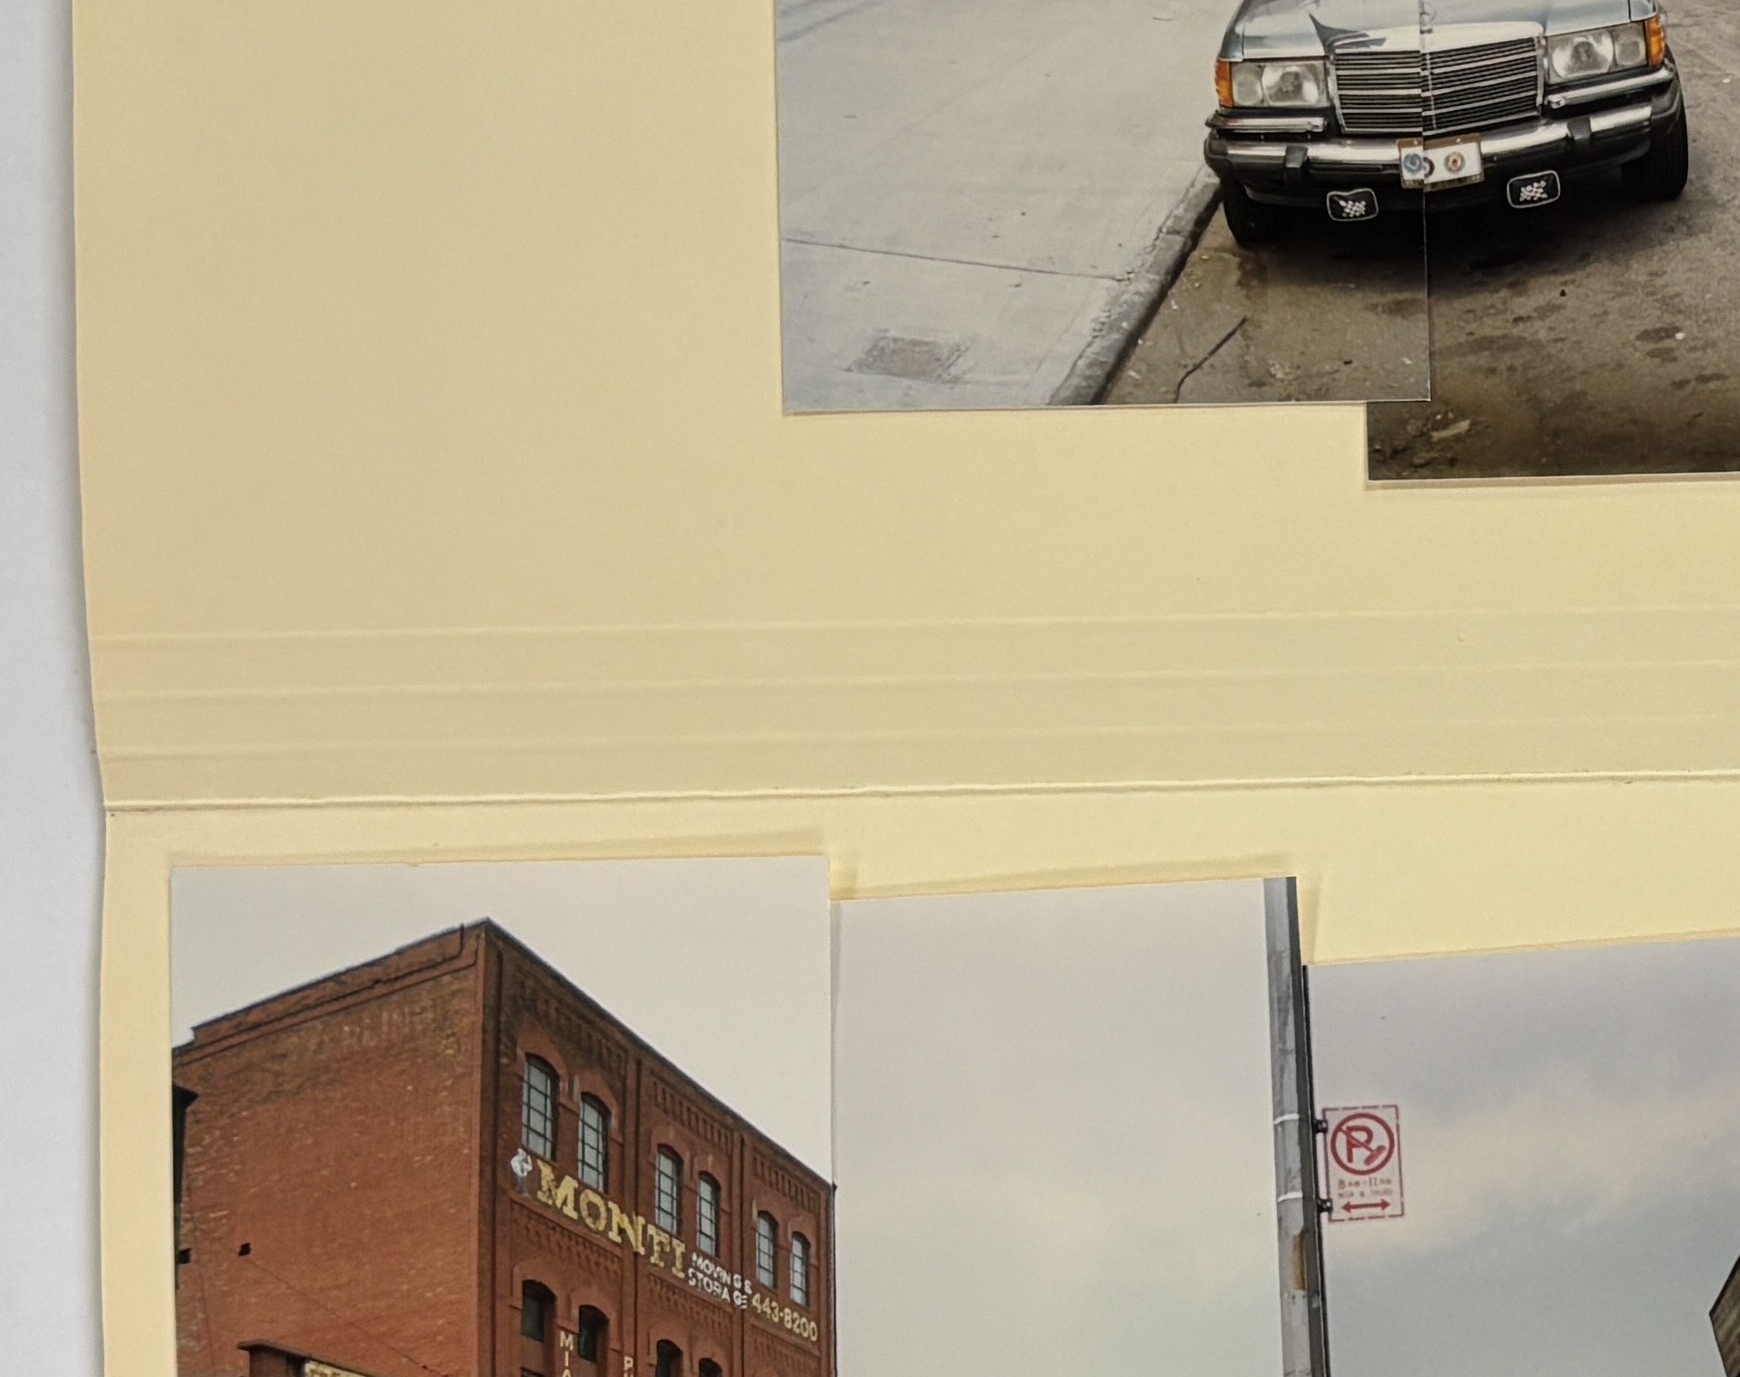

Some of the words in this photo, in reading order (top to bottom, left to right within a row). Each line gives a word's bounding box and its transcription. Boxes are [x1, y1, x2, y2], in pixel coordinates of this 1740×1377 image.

[536, 1158, 686, 1279] MONTI
[687, 1267, 748, 1310] STORAGE
[691, 1252, 743, 1289] MOVING
[752, 1292, 819, 1342] 443-8200
